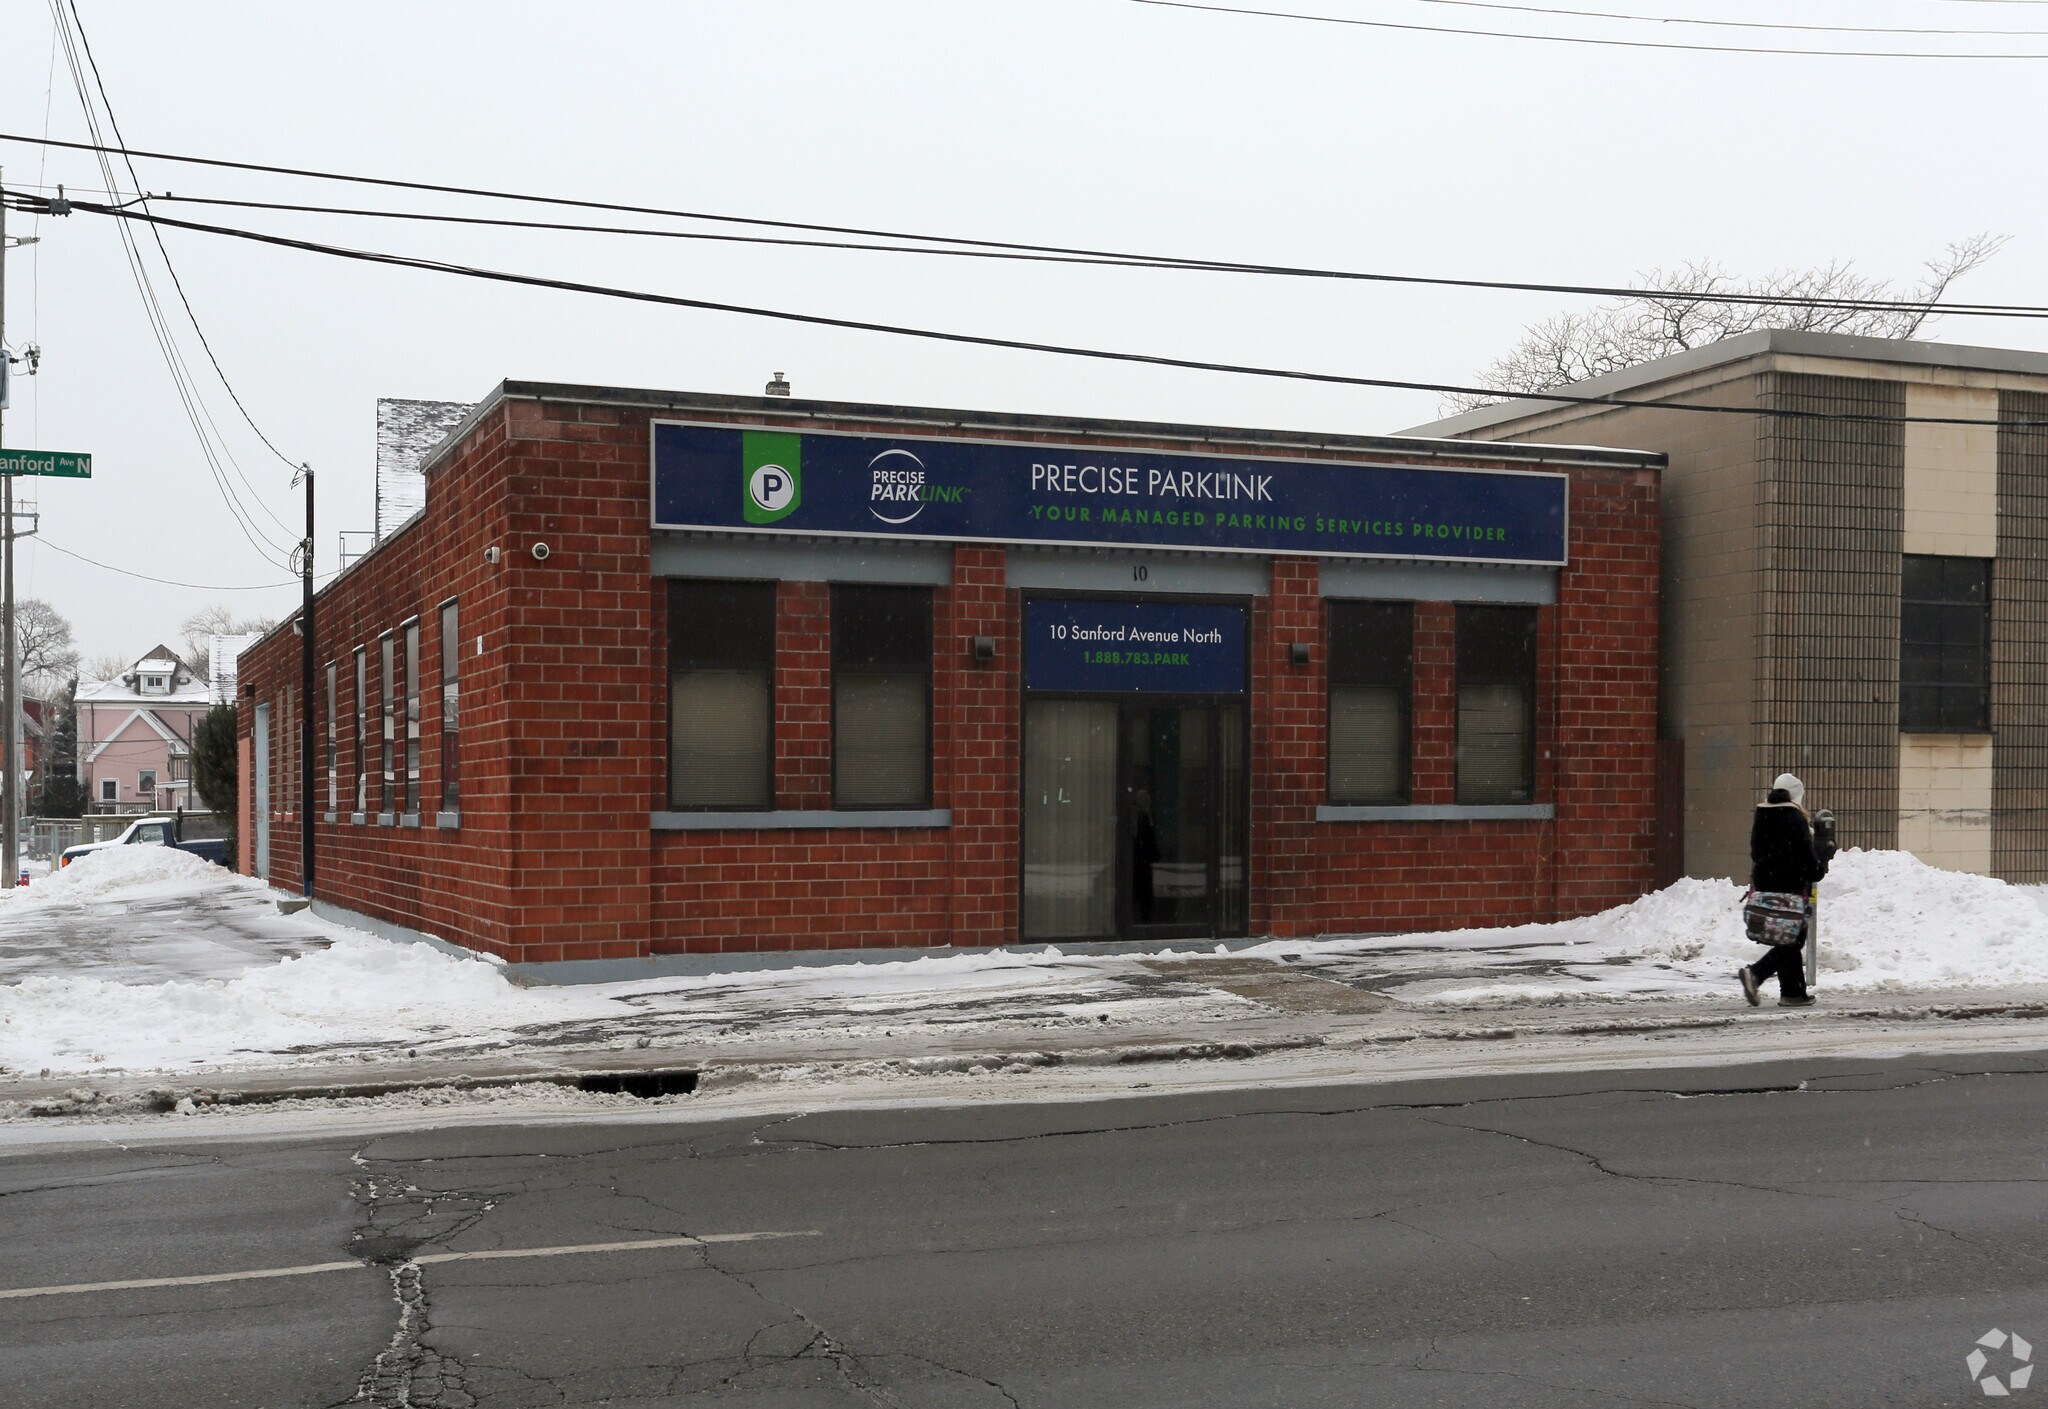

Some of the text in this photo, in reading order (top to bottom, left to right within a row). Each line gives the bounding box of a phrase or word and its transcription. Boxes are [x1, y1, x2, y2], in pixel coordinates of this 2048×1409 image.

[0, 455, 90, 473] anford Ave N
[873, 470, 925, 484] PRECISE
[1031, 463, 1273, 502] PRECISE PARKLINK
[763, 474, 782, 501] P
[1032, 504, 1506, 541] YOUR MANAGED PARKING SERVICES PROVIDER
[1133, 565, 1148, 582] 10
[1050, 624, 1222, 644] 10 Sanford Avenue North
[1084, 651, 1189, 665] 1.888.783.PARK
